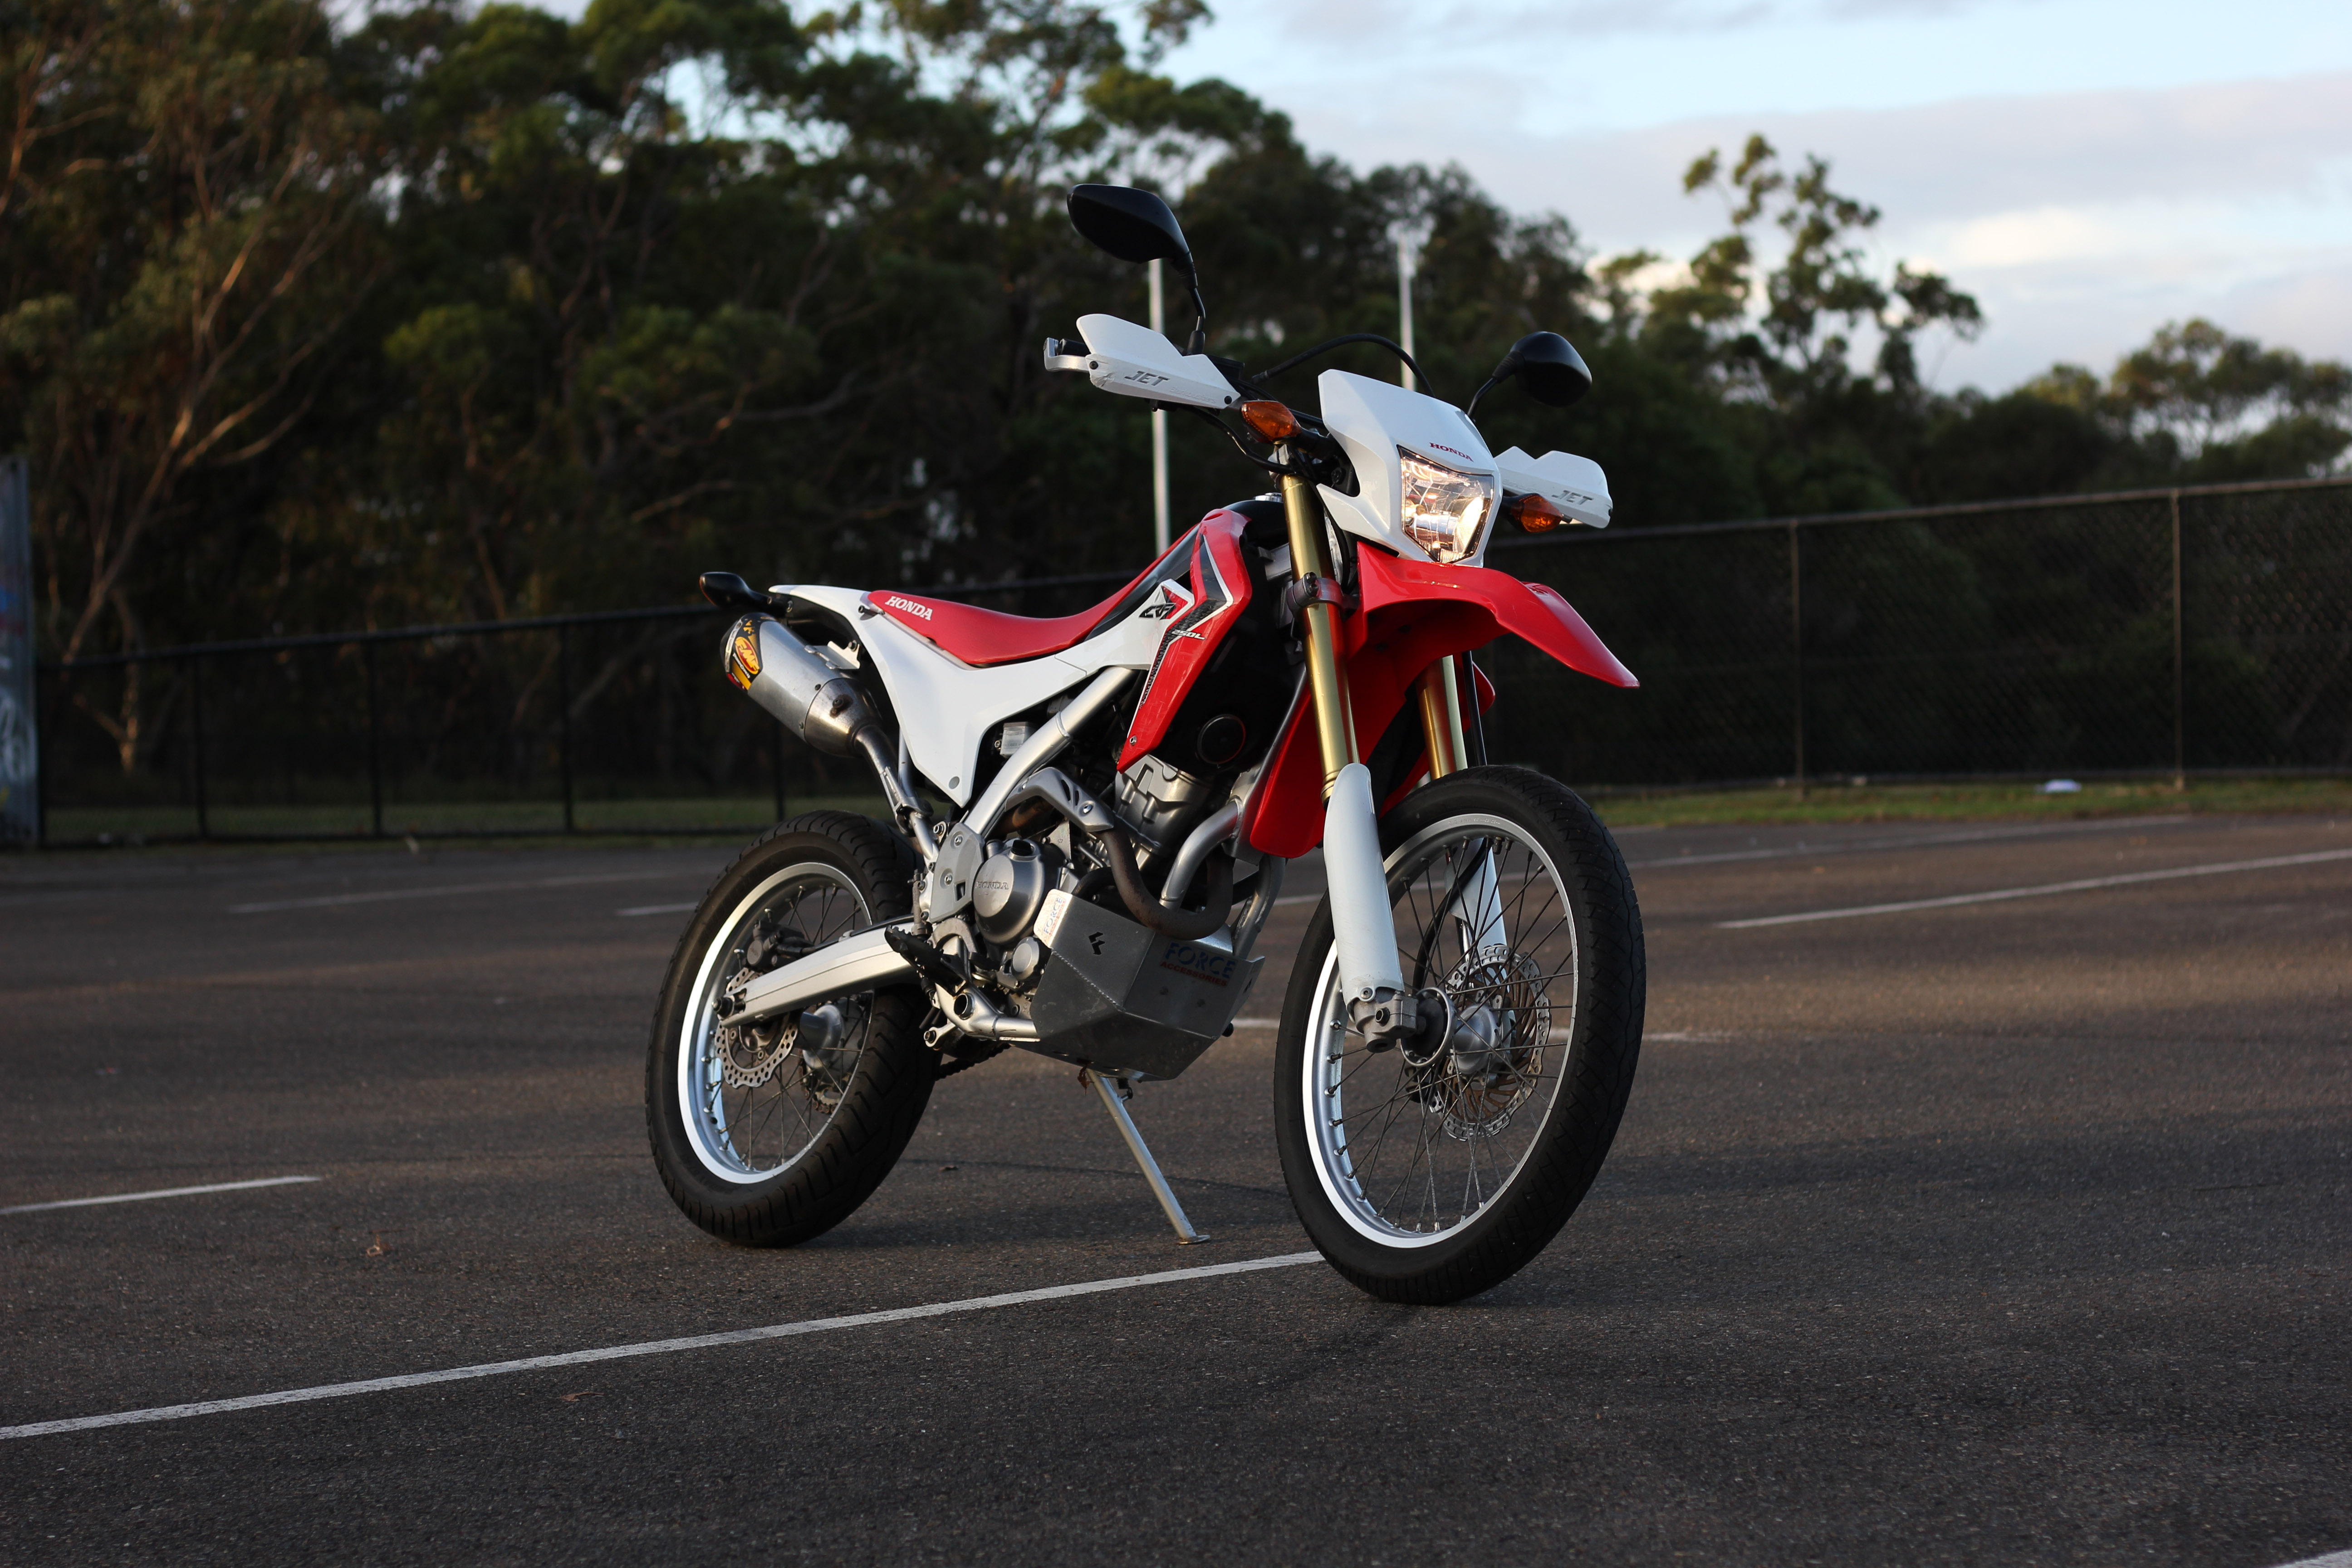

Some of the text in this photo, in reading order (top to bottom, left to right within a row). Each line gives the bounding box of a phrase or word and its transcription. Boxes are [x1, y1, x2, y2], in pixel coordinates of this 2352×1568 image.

[1124, 370, 1171, 386] JET
[1429, 442, 1474, 463] HONDA
[1551, 490, 1594, 505] JET
[884, 595, 933, 621] HONDA
[1171, 629, 1205, 640] 250L
[735, 637, 760, 671] FMF
[975, 881, 1009, 890] HONDA
[1044, 897, 1063, 934] FORCE
[1165, 942, 1236, 979] FORCE
[1160, 961, 1228, 986] ACCESSORIES
